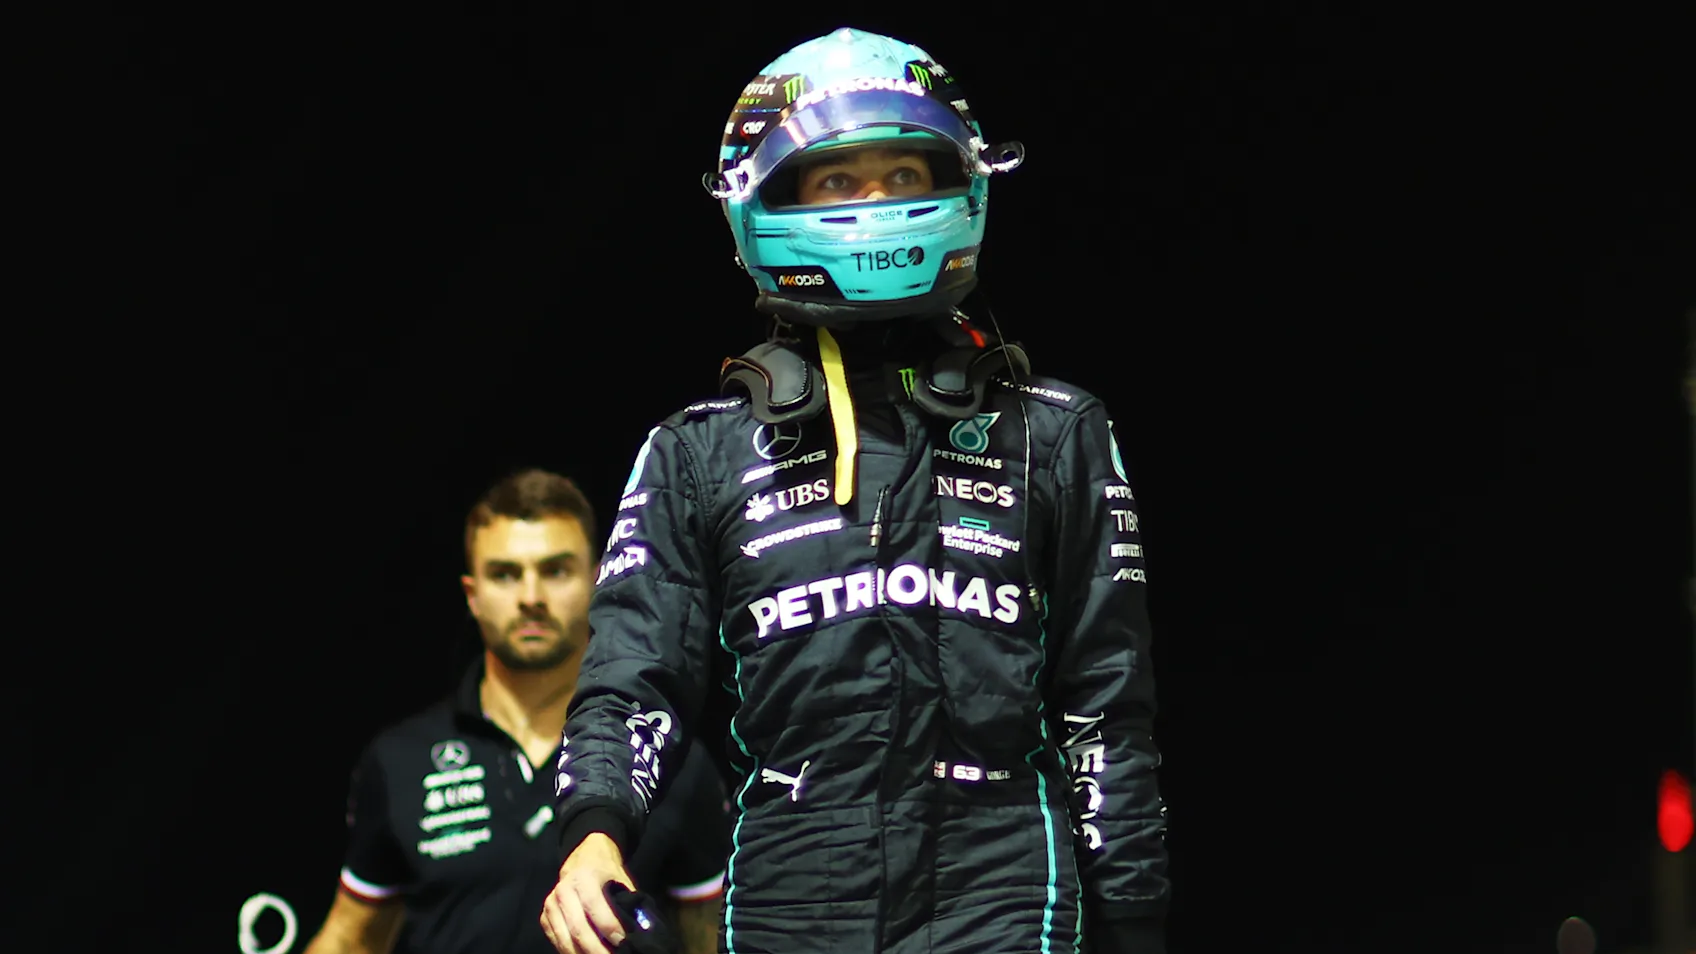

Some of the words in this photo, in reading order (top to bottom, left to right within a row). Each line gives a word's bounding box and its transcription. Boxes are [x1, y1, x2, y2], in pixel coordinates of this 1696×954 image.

[870, 210, 903, 219] OLICE
[851, 246, 924, 272] TIBCO
[933, 449, 1003, 470] PETRONAS
[775, 479, 830, 511] UBS
[746, 518, 844, 552] CROWDSTRIKE
[943, 534, 1004, 558] Enterprise
[747, 564, 1022, 639] PETRONAS
[952, 764, 982, 781] 63
